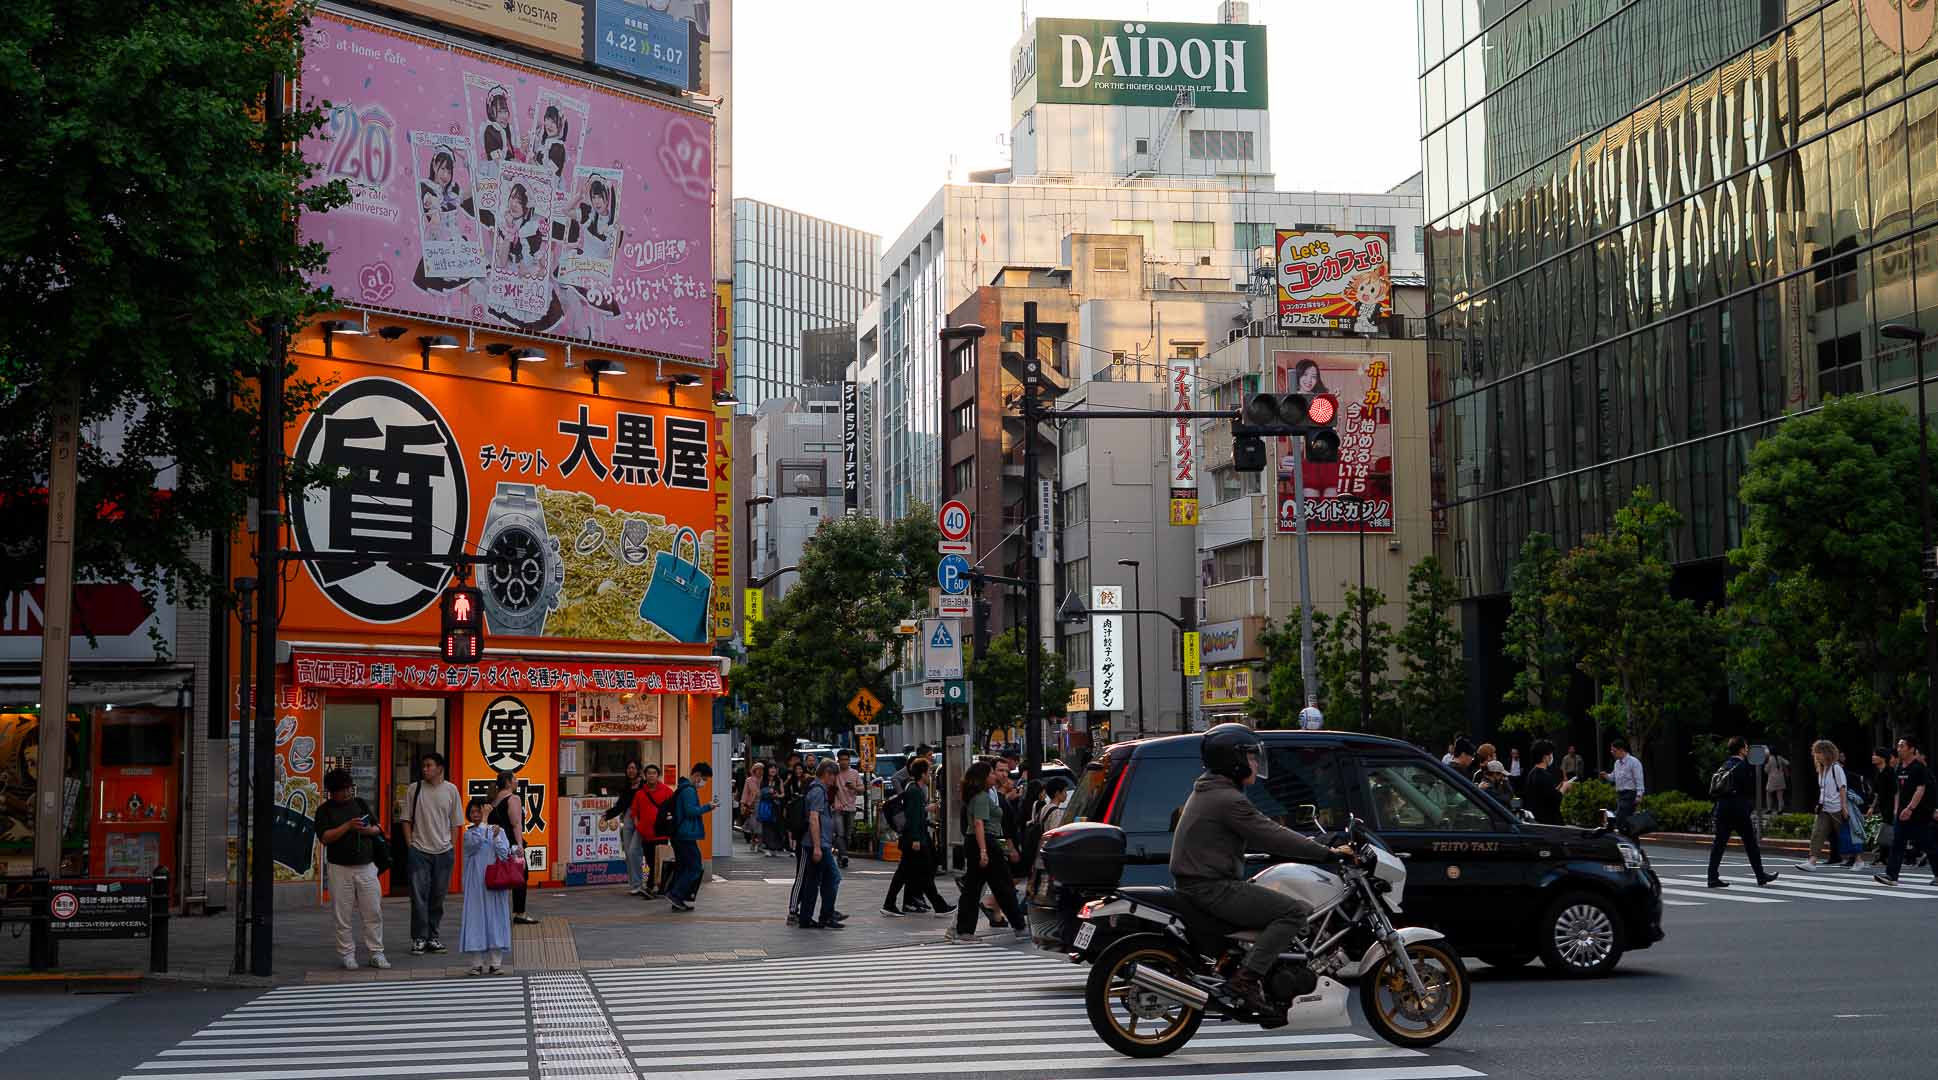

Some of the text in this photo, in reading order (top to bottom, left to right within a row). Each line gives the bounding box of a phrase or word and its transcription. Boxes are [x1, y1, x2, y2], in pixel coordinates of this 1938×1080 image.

[516, 1, 558, 23] YOSTAR
[606, 30, 637, 53] 4.22
[653, 43, 683, 65] 5.07
[1094, 82, 1111, 90] FOR
[1111, 82, 1125, 90] THE
[1126, 83, 1154, 91] HIGHER
[1155, 84, 1187, 92] QUALITY
[1196, 85, 1212, 93] LIFE
[349, 200, 399, 222] nniversary
[1291, 240, 1330, 261] Let's
[1283, 312, 1326, 325] カフェるん
[479, 404, 710, 492] チケット 大黒屋
[845, 384, 857, 490] ダイナミックオーディオ
[312, 414, 449, 593] 質
[946, 511, 964, 530] 40
[945, 565, 958, 590] P
[953, 578, 964, 590] 60
[1102, 618, 1115, 708] 肉汁餃子のダンダダン
[297, 658, 366, 685] 高価買取
[665, 669, 722, 692] 無料査定
[487, 707, 528, 766] 質
[1432, 841, 1499, 852] TEITO TAXI
